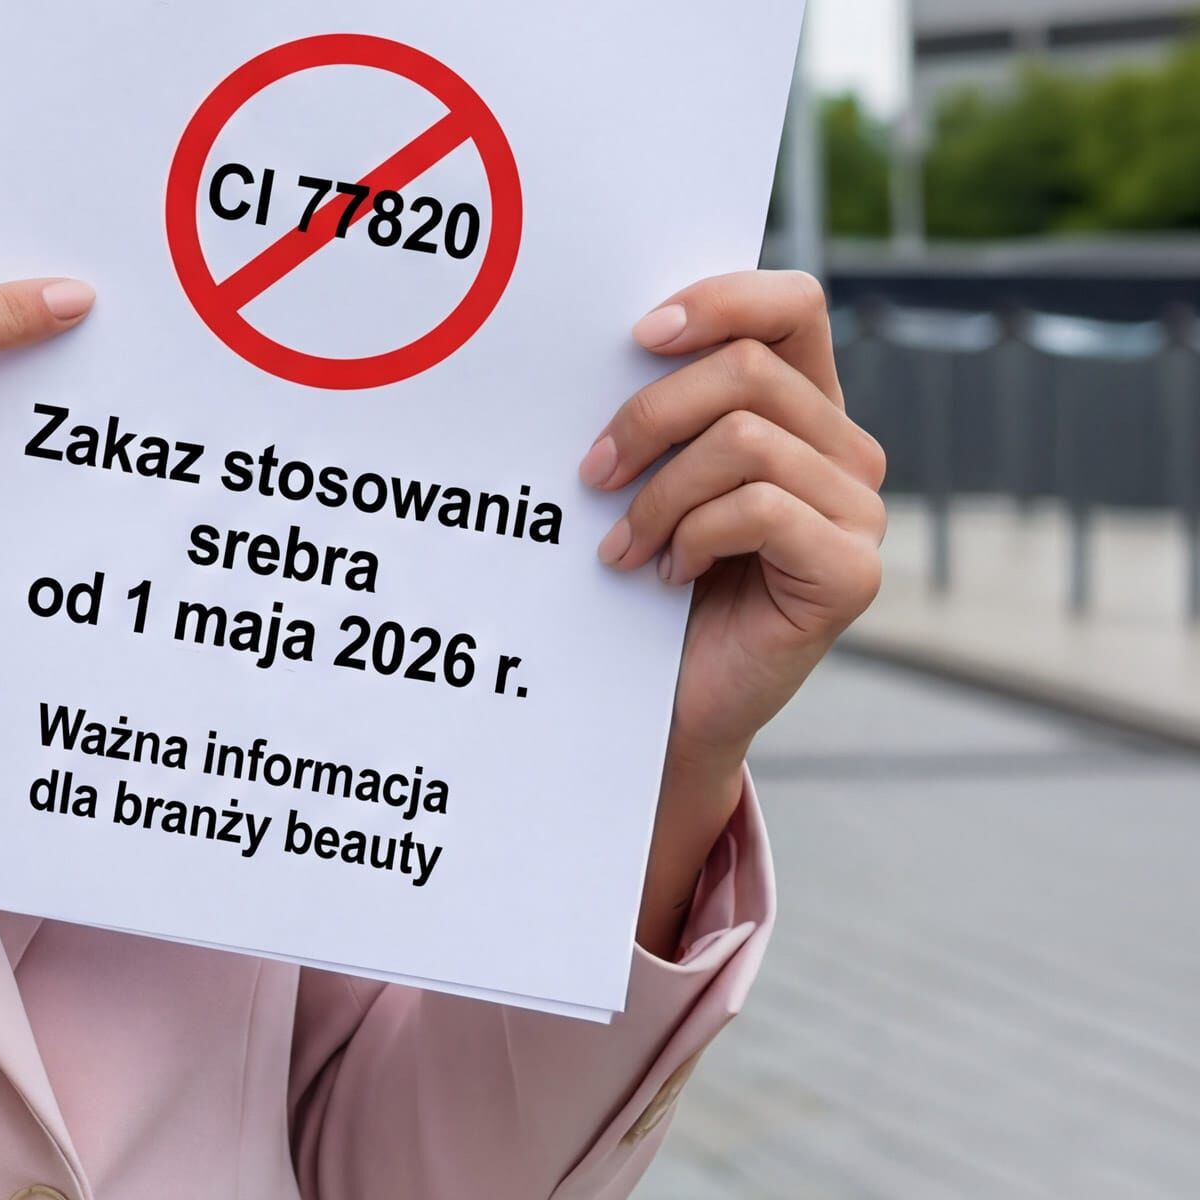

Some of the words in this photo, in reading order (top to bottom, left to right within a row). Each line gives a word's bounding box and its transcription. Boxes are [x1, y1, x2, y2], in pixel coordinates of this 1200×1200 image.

[209, 163, 275, 226] CI
[297, 175, 480, 260] 77820
[24, 403, 205, 484] Zakaz
[220, 444, 563, 545] stosowania
[187, 524, 379, 593] srebra
[27, 571, 105, 626] od
[127, 579, 152, 634] 1
[174, 601, 315, 669] maja
[333, 615, 477, 688] 2026
[494, 655, 528, 698] r.
[39, 702, 188, 770] Ważna
[203, 730, 449, 821] informacja
[29, 769, 98, 819] dla
[113, 780, 273, 858] branży
[284, 809, 443, 887] beauty
